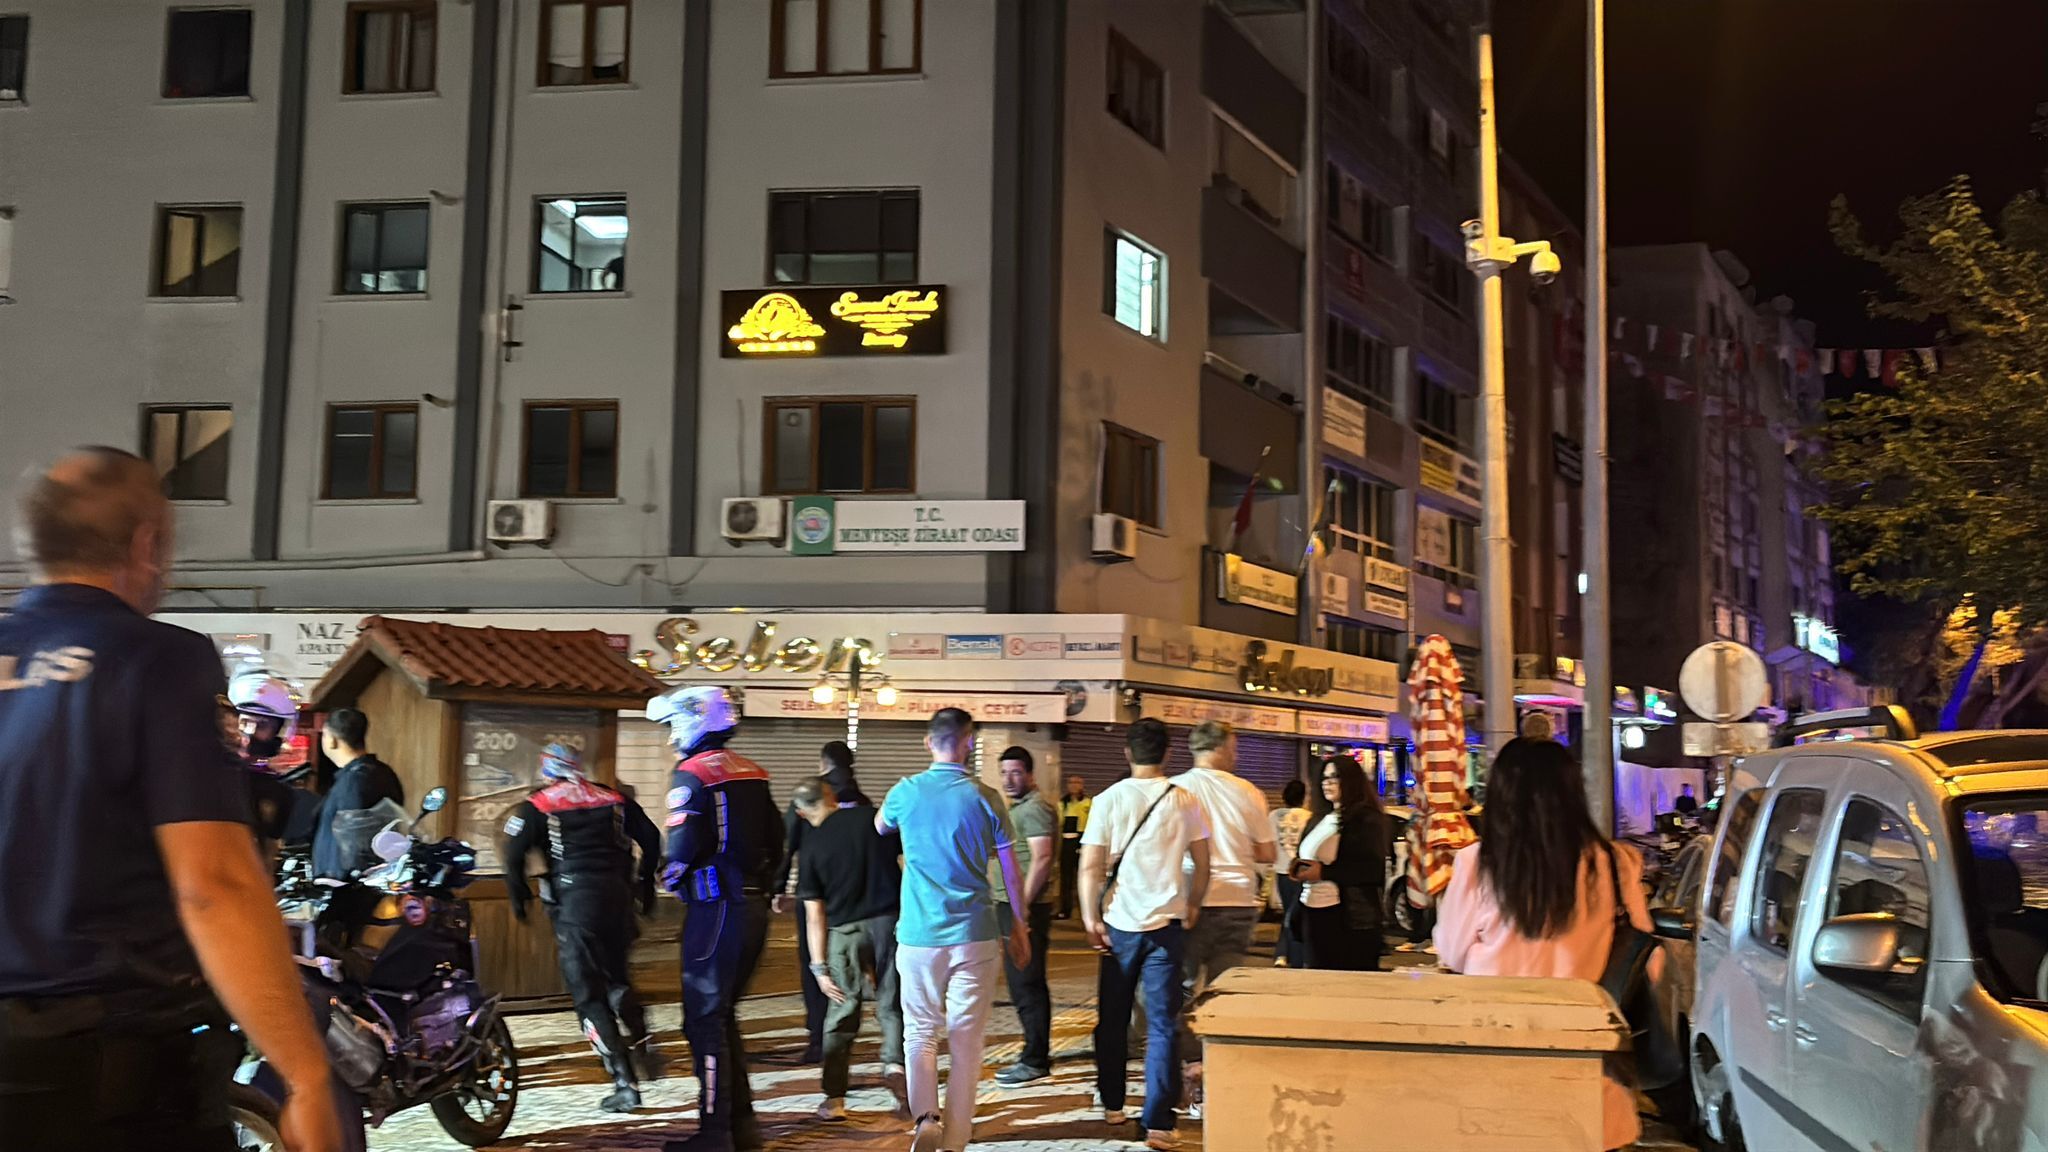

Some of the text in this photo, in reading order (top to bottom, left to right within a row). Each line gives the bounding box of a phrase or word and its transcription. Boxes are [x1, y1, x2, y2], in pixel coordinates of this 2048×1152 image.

[630, 616, 885, 677] Selen
[472, 731, 518, 751] 200
[471, 802, 509, 821] 20
